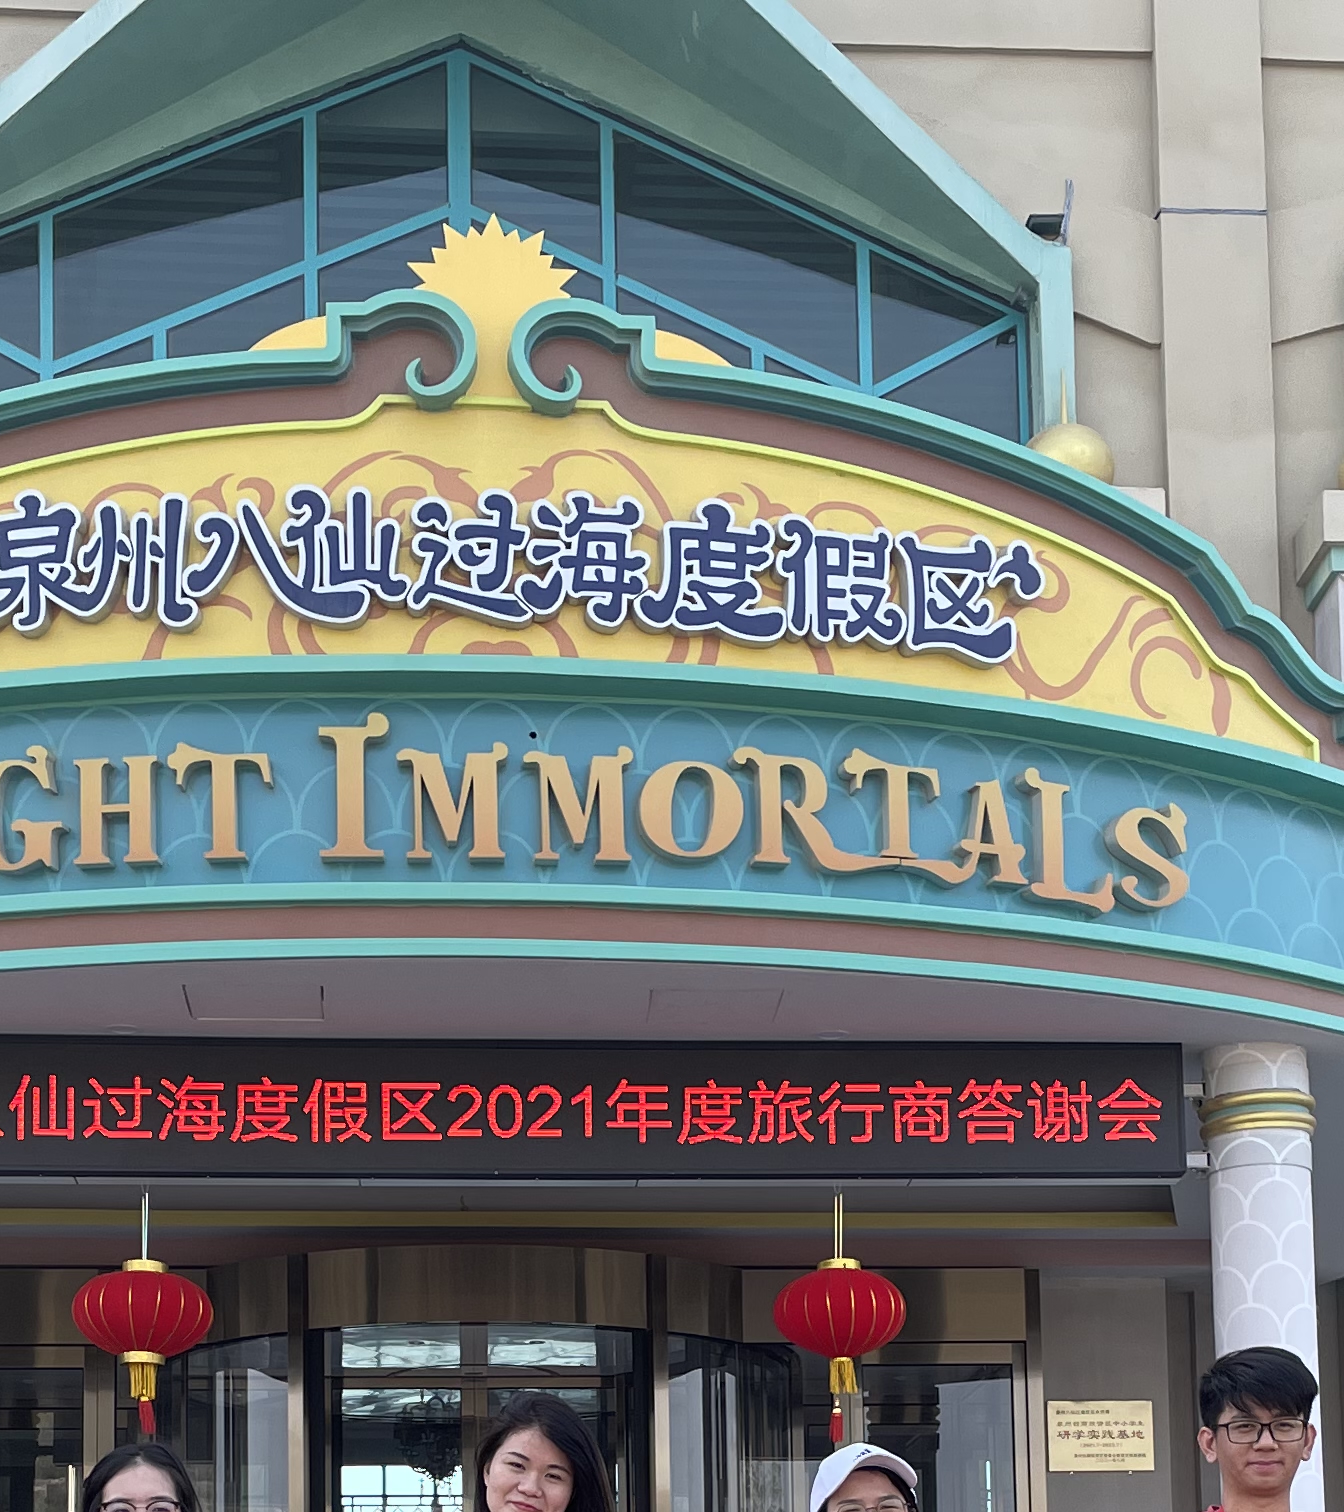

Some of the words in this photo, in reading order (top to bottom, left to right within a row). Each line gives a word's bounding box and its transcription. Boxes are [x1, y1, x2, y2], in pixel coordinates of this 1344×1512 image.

[1057, 1429, 1145, 1440] 研学实践基地
